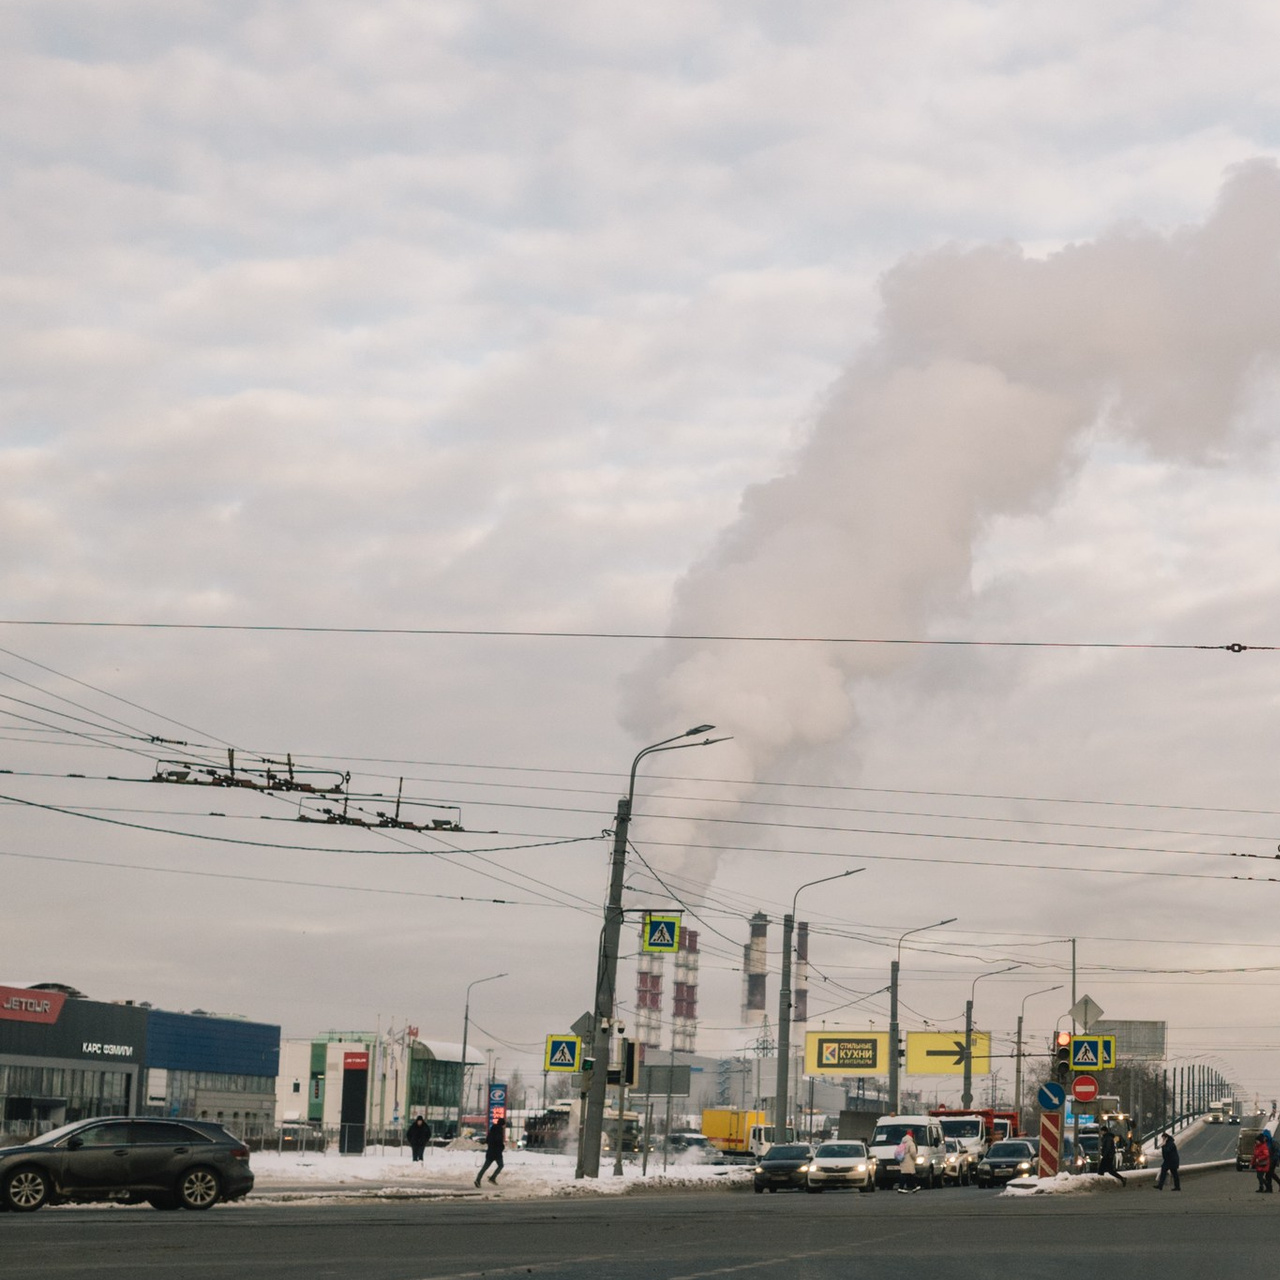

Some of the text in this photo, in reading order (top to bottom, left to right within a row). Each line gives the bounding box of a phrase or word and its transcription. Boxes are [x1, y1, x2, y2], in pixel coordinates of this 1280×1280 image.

[4, 997, 51, 1013] JETOUR
[82, 1042, 102, 1054] КАРС
[840, 1050, 872, 1058] КУХНИ
